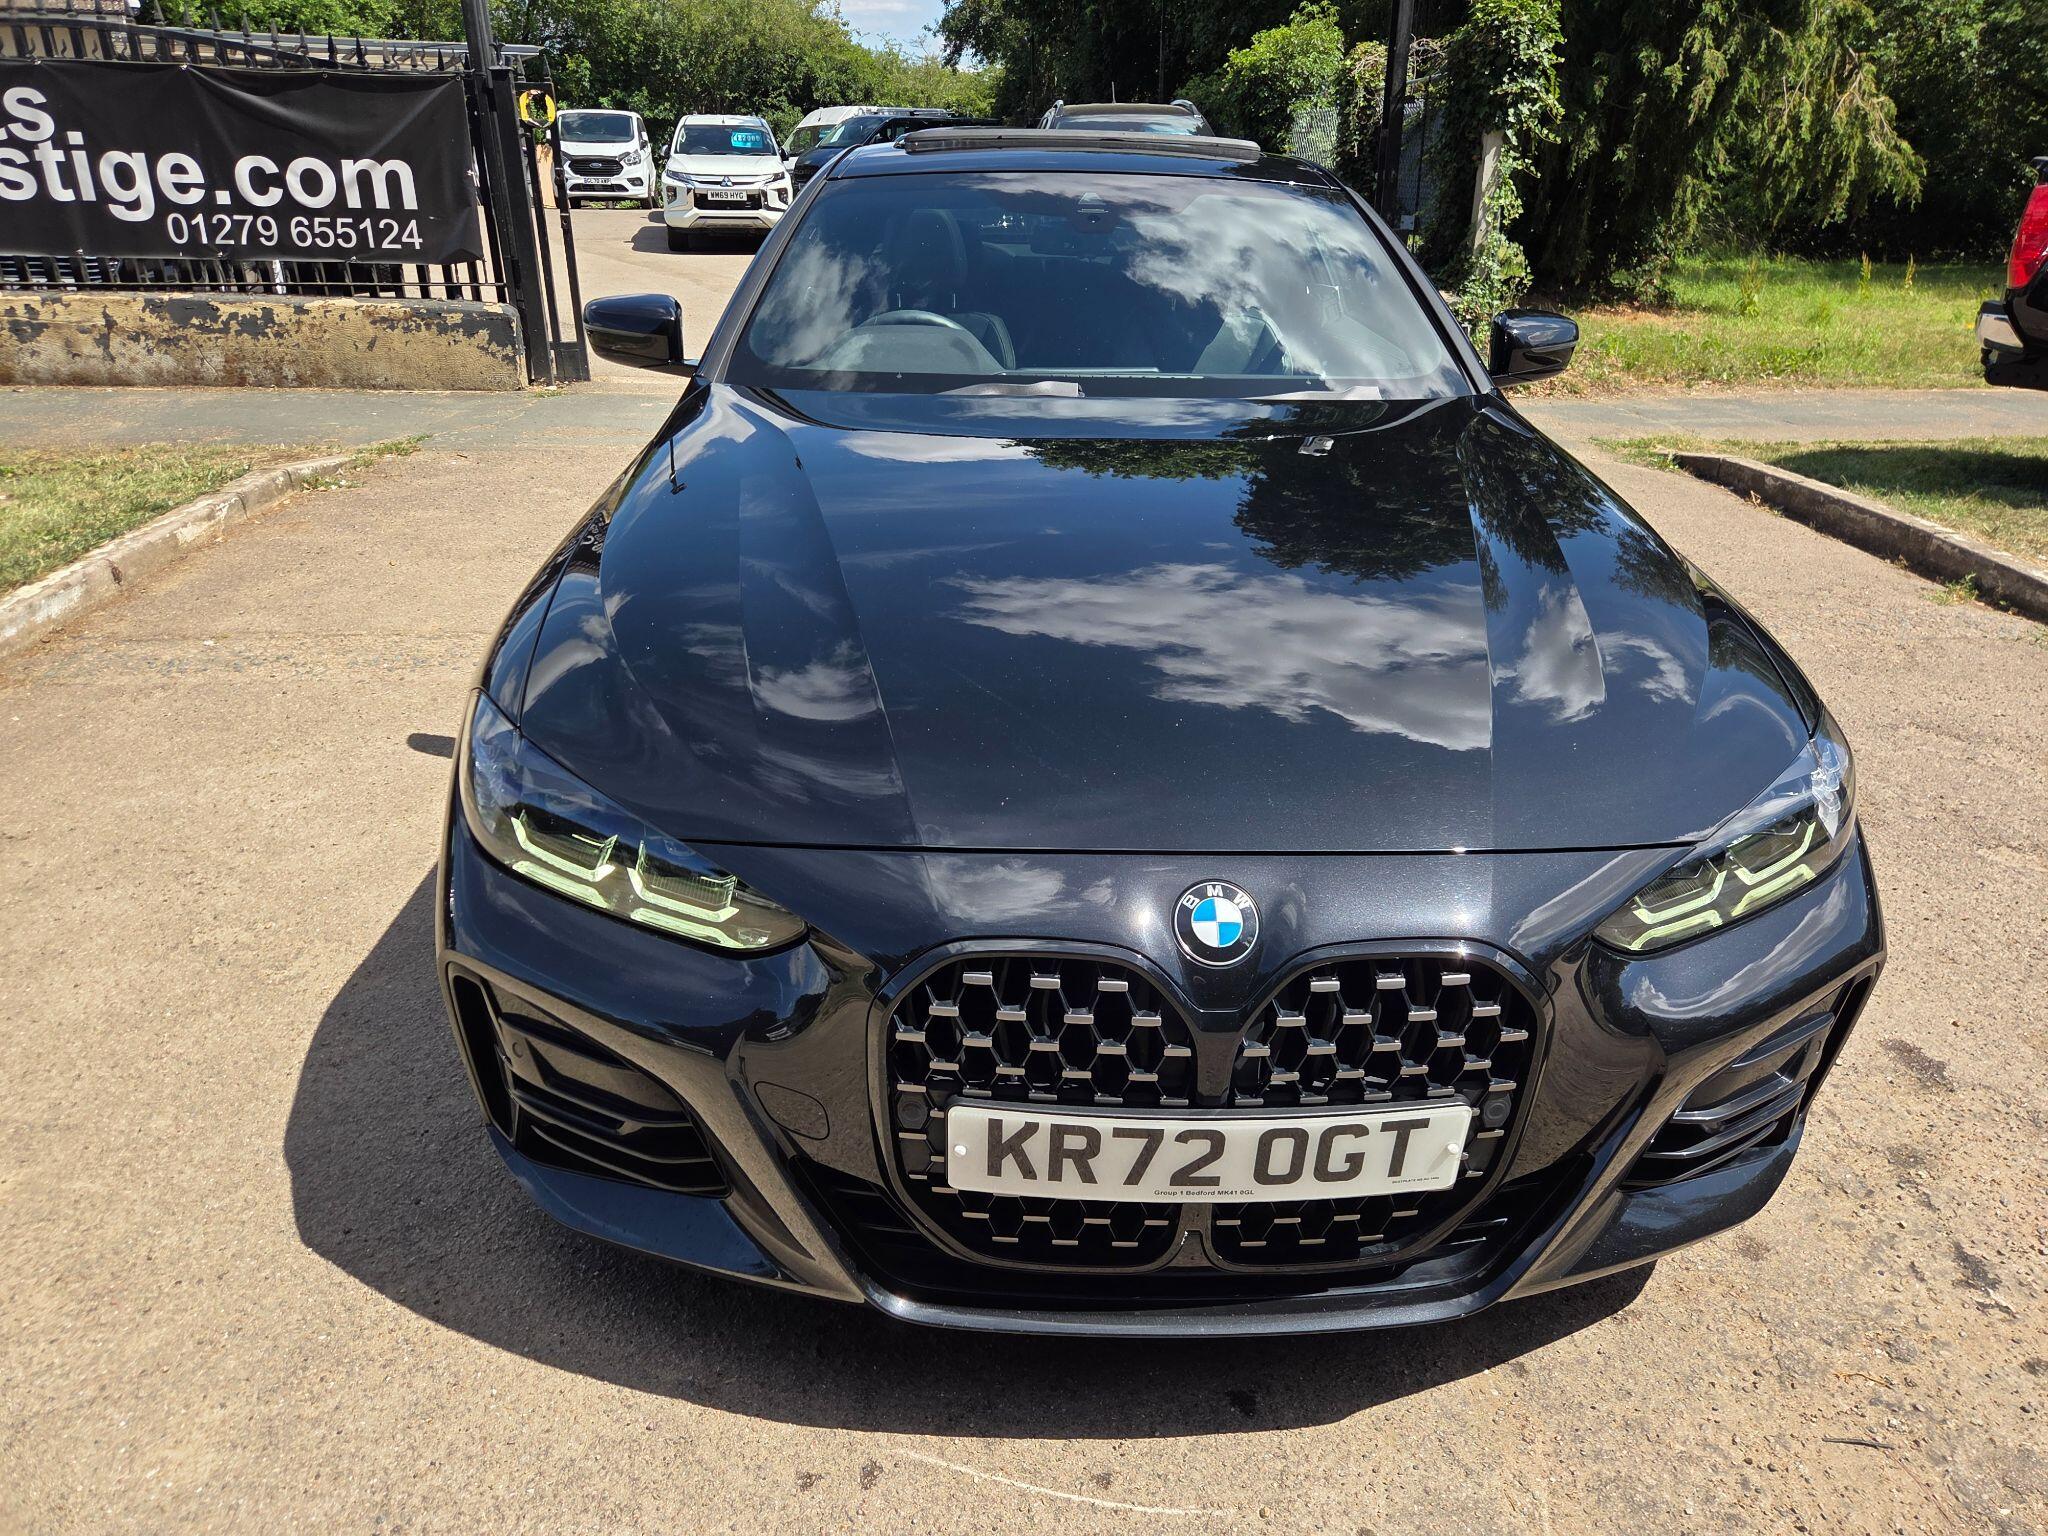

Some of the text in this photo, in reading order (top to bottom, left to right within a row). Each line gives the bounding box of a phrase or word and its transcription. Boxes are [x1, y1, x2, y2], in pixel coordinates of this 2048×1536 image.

[167, 213, 424, 250] 01279 655124
[1182, 885, 1251, 910] BMW
[986, 1117, 1430, 1187] KR72 OGT
[1154, 1189, 1178, 1197] Group
